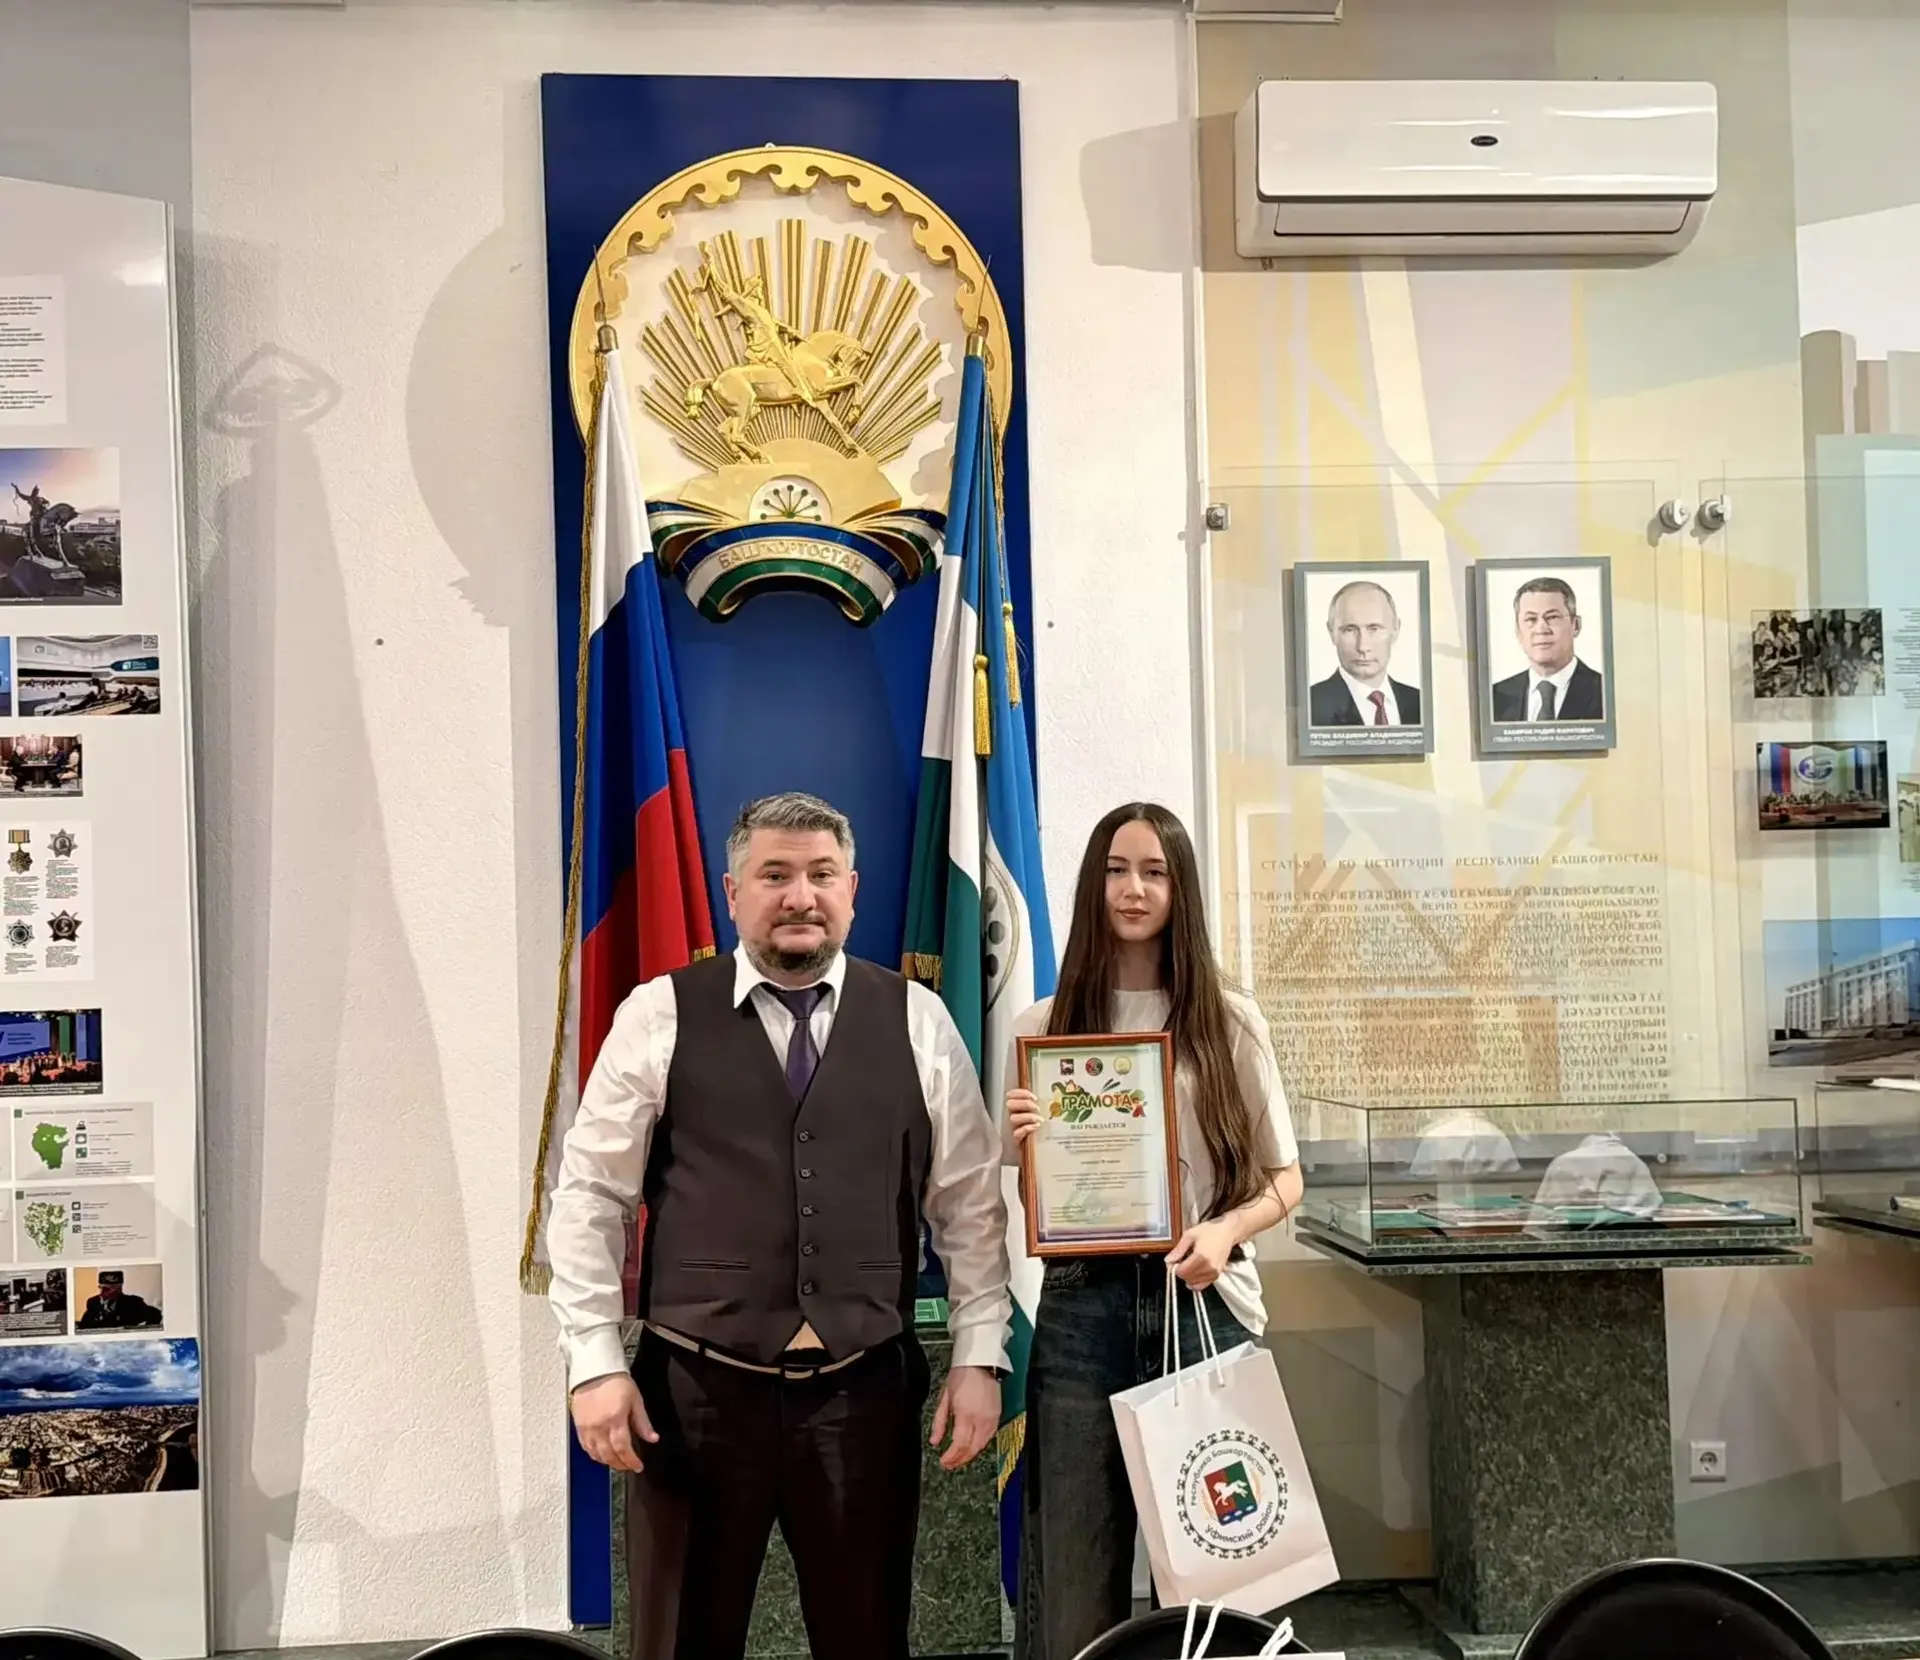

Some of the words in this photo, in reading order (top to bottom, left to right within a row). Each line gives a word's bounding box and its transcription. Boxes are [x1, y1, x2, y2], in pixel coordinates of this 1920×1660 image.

[1455, 856, 1540, 867] РЕСПУБЛИКИ
[1551, 854, 1659, 866] БАШКОРТОСТАН
[1061, 1094, 1132, 1109] ГРАМОТА
[1205, 1523, 1255, 1543] Уфимский
[1255, 1501, 1274, 1533] район
